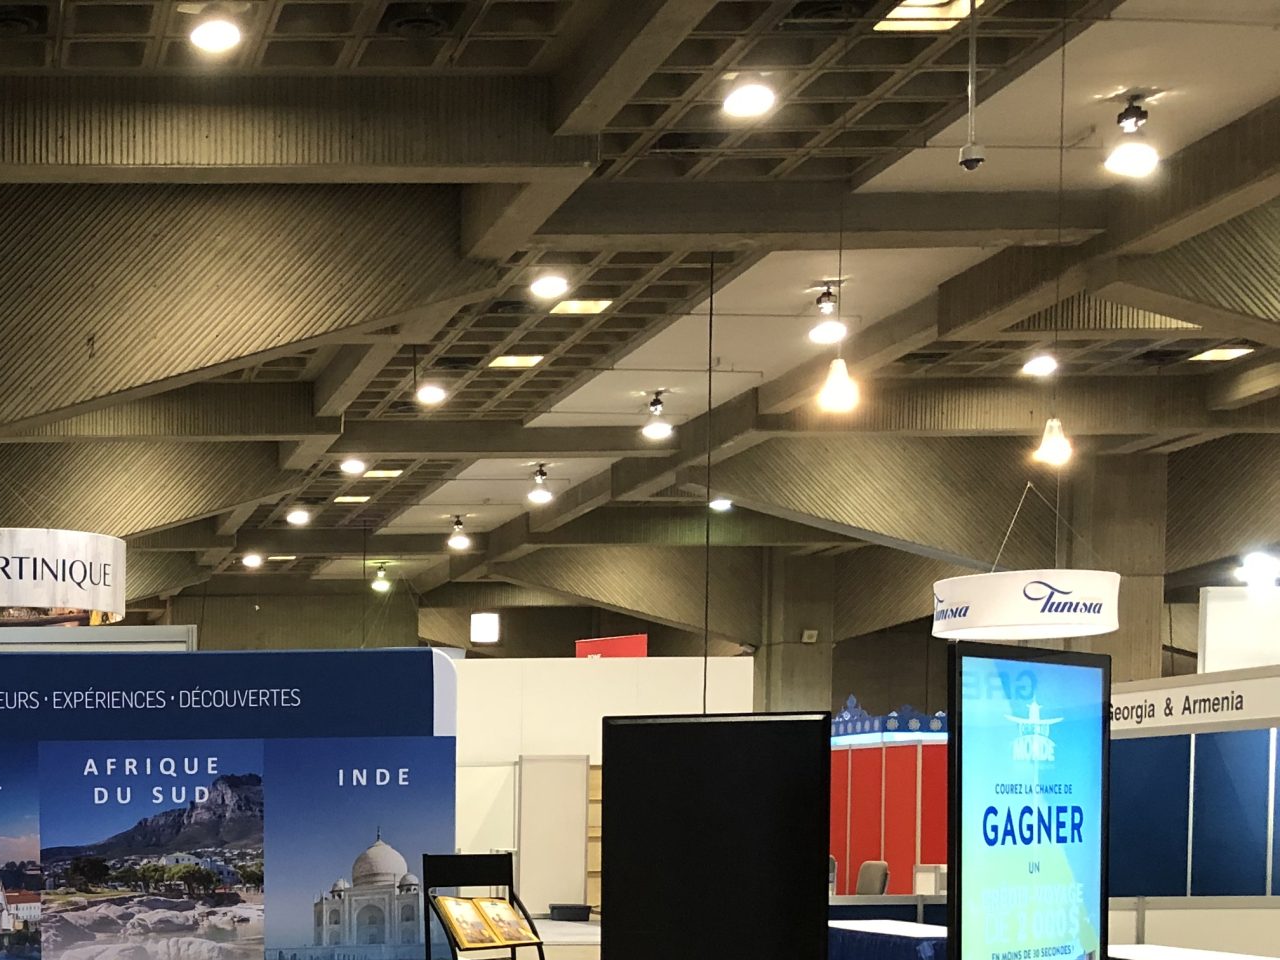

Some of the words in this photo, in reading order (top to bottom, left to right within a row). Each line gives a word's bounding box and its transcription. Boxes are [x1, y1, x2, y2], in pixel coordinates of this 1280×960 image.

[1023, 581, 1103, 614] Tunisia
[53, 687, 166, 709] EXPÉRIENCES
[180, 686, 301, 708] DÉCOUVERTES
[1110, 699, 1155, 724] Georgia
[1164, 697, 1173, 717] &
[1181, 690, 1244, 715] Armenia
[83, 757, 218, 777] AFRIQUE
[338, 768, 410, 786] INDE
[94, 787, 131, 804] DU
[152, 787, 210, 804] SUD
[995, 784, 1023, 795] COUREZ
[1025, 784, 1033, 794] LA
[1035, 783, 1062, 794] CHANCE
[1064, 784, 1072, 794] DE
[982, 805, 1084, 846] GAGNER
[1028, 862, 1040, 874] UN
[1001, 951, 1022, 960] MOINS
[1024, 949, 1031, 959] DE
[1041, 945, 1071, 957] SECONDES
